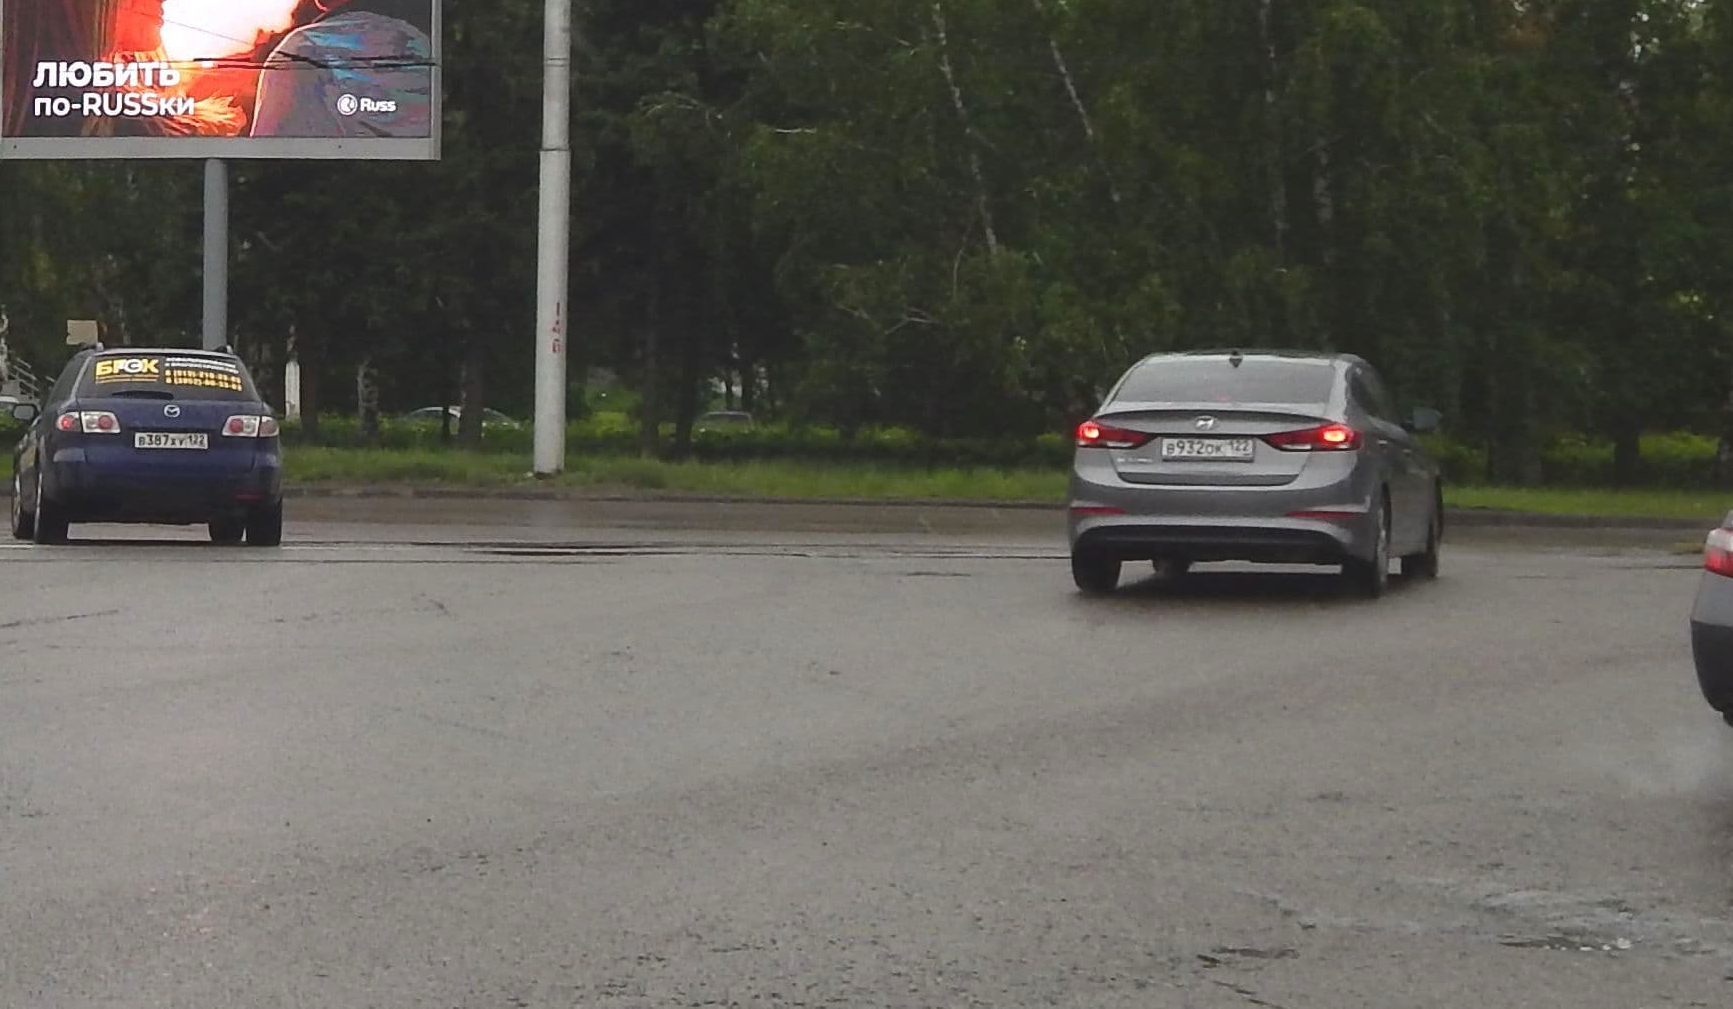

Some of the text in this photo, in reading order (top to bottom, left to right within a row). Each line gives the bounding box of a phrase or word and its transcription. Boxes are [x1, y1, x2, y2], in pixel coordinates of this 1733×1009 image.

[33, 61, 181, 88] ЛЮБИТЬ
[34, 92, 195, 117] по-RUSSки
[360, 97, 397, 112] Russ
